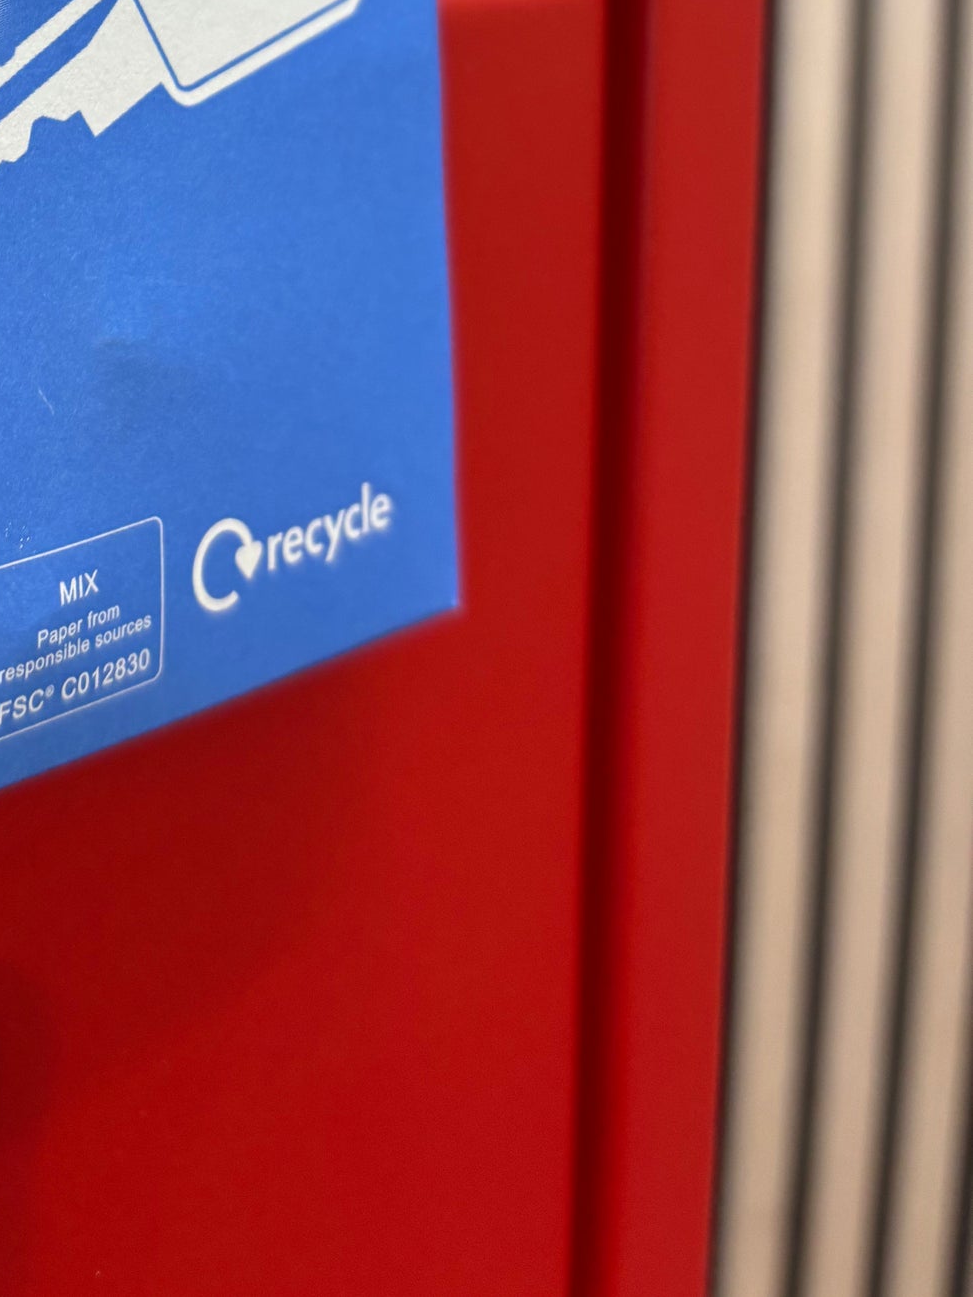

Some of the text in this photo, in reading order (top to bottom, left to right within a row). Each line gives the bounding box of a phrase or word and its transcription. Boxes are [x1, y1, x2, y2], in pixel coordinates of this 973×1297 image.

[267, 481, 392, 571] recycle
[59, 569, 99, 606] MIX
[37, 604, 120, 648] Paper from
[95, 614, 152, 648] sources
[61, 648, 151, 701] C012830
